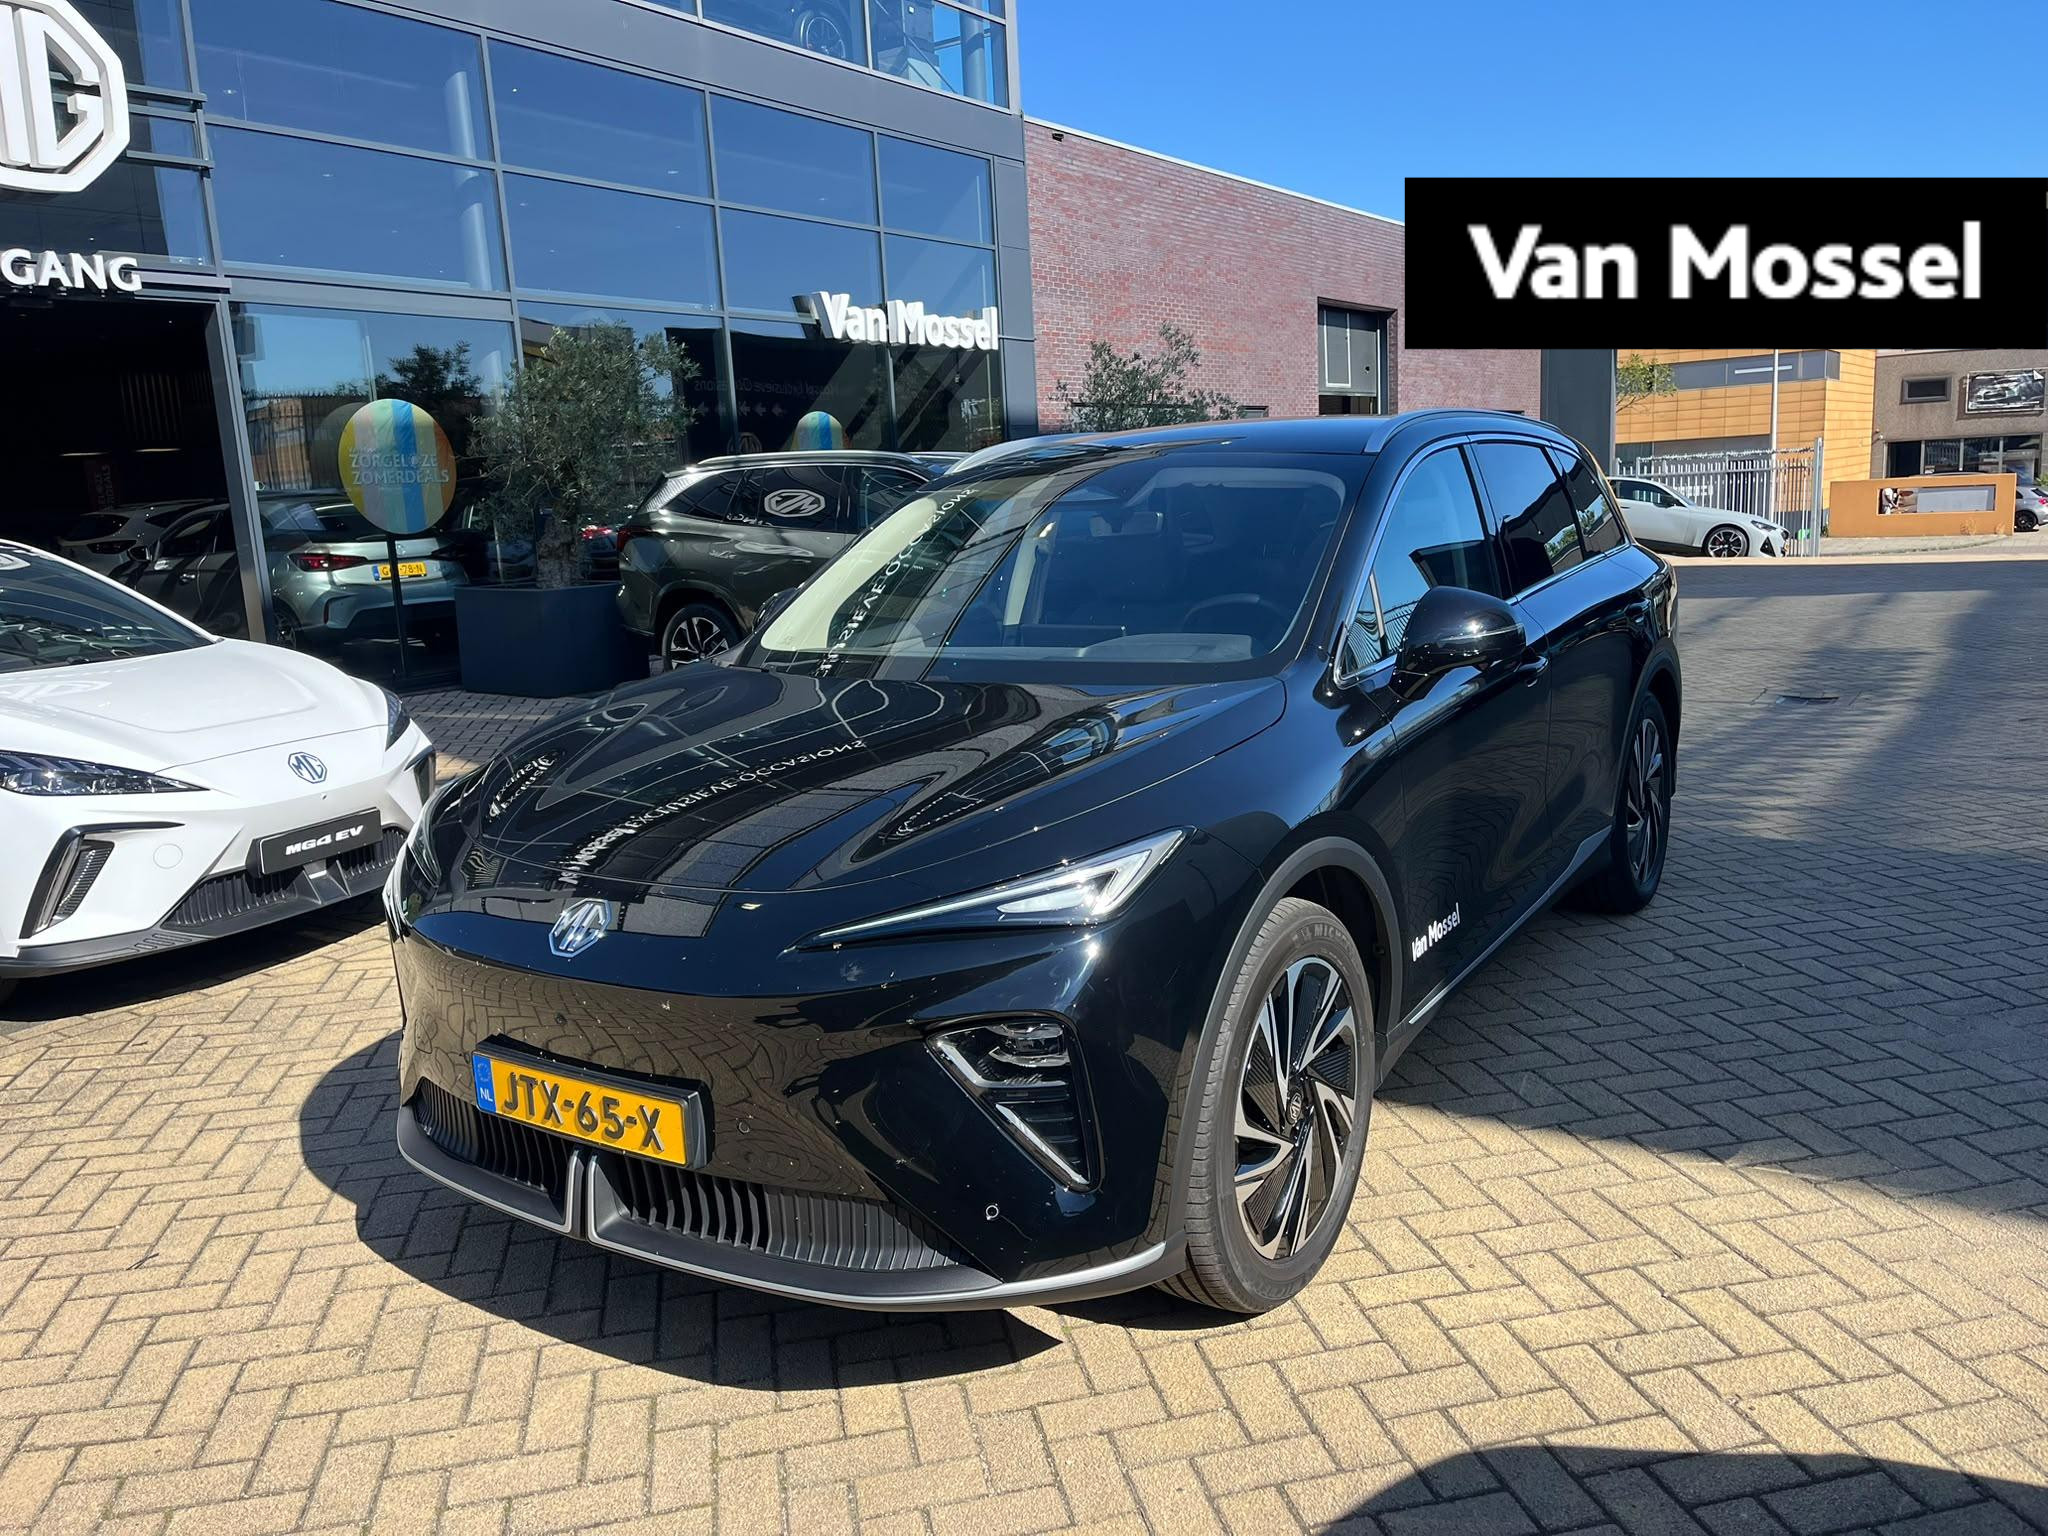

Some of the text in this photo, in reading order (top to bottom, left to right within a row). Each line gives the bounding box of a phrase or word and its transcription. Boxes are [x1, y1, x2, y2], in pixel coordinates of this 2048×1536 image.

[0, 248, 143, 292] GANG
[812, 291, 999, 350] Van Mossel
[352, 469, 449, 485] ZOMERDEALS
[381, 565, 424, 577] G-78-N
[290, 753, 325, 782] MG
[286, 825, 364, 855] MG4 EV
[551, 900, 608, 954] MG
[1411, 902, 1460, 962] Van Mossel
[480, 1087, 494, 1103] NL
[502, 1071, 665, 1153] JTX-65-X
